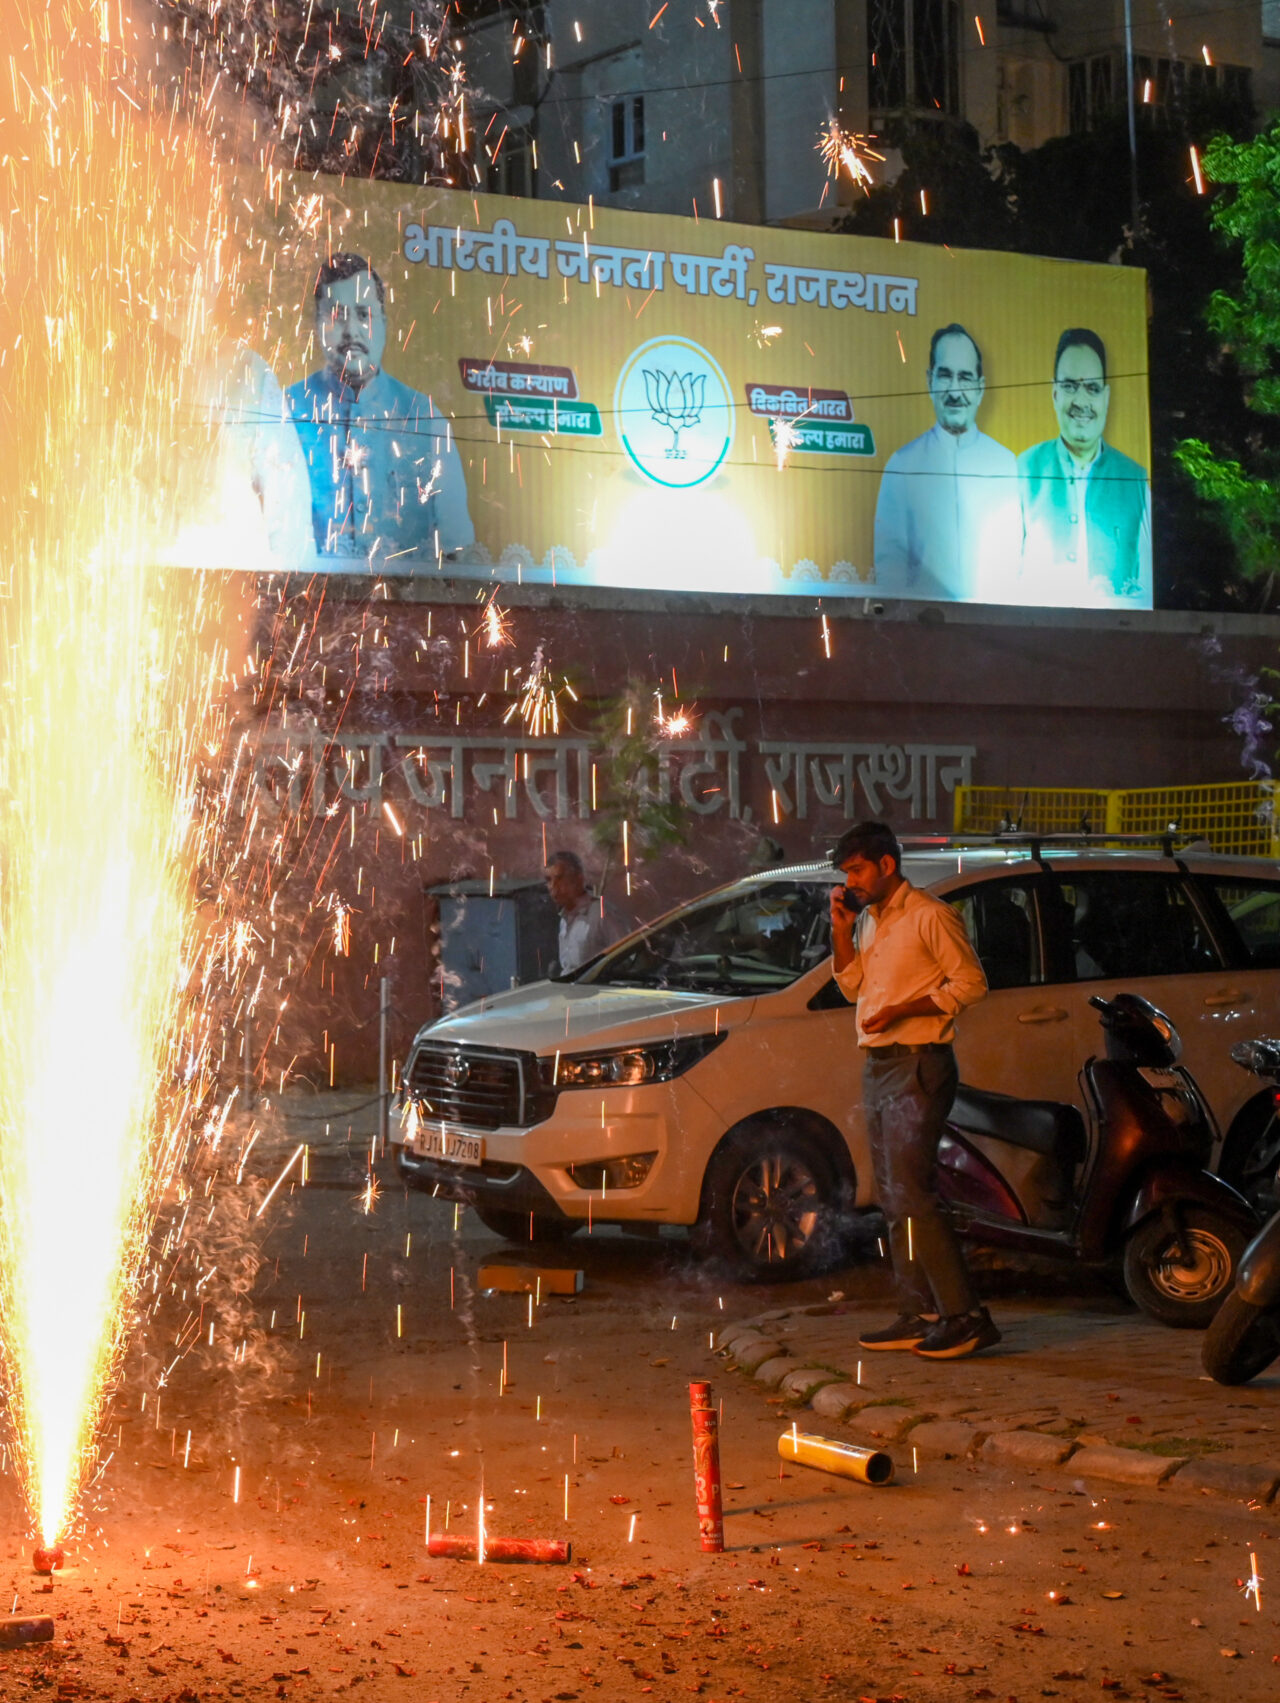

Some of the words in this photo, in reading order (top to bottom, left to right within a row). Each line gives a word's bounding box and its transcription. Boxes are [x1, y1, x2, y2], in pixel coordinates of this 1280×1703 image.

[403, 218, 551, 279] भारतीय
[554, 239, 666, 292] जनता
[669, 243, 759, 306] पार्टी,
[764, 262, 919, 316] राजस्थान
[510, 370, 569, 394] कल्याण
[825, 430, 865, 449] हमारा
[395, 735, 598, 820] जनता
[759, 740, 976, 820] राजस्थान
